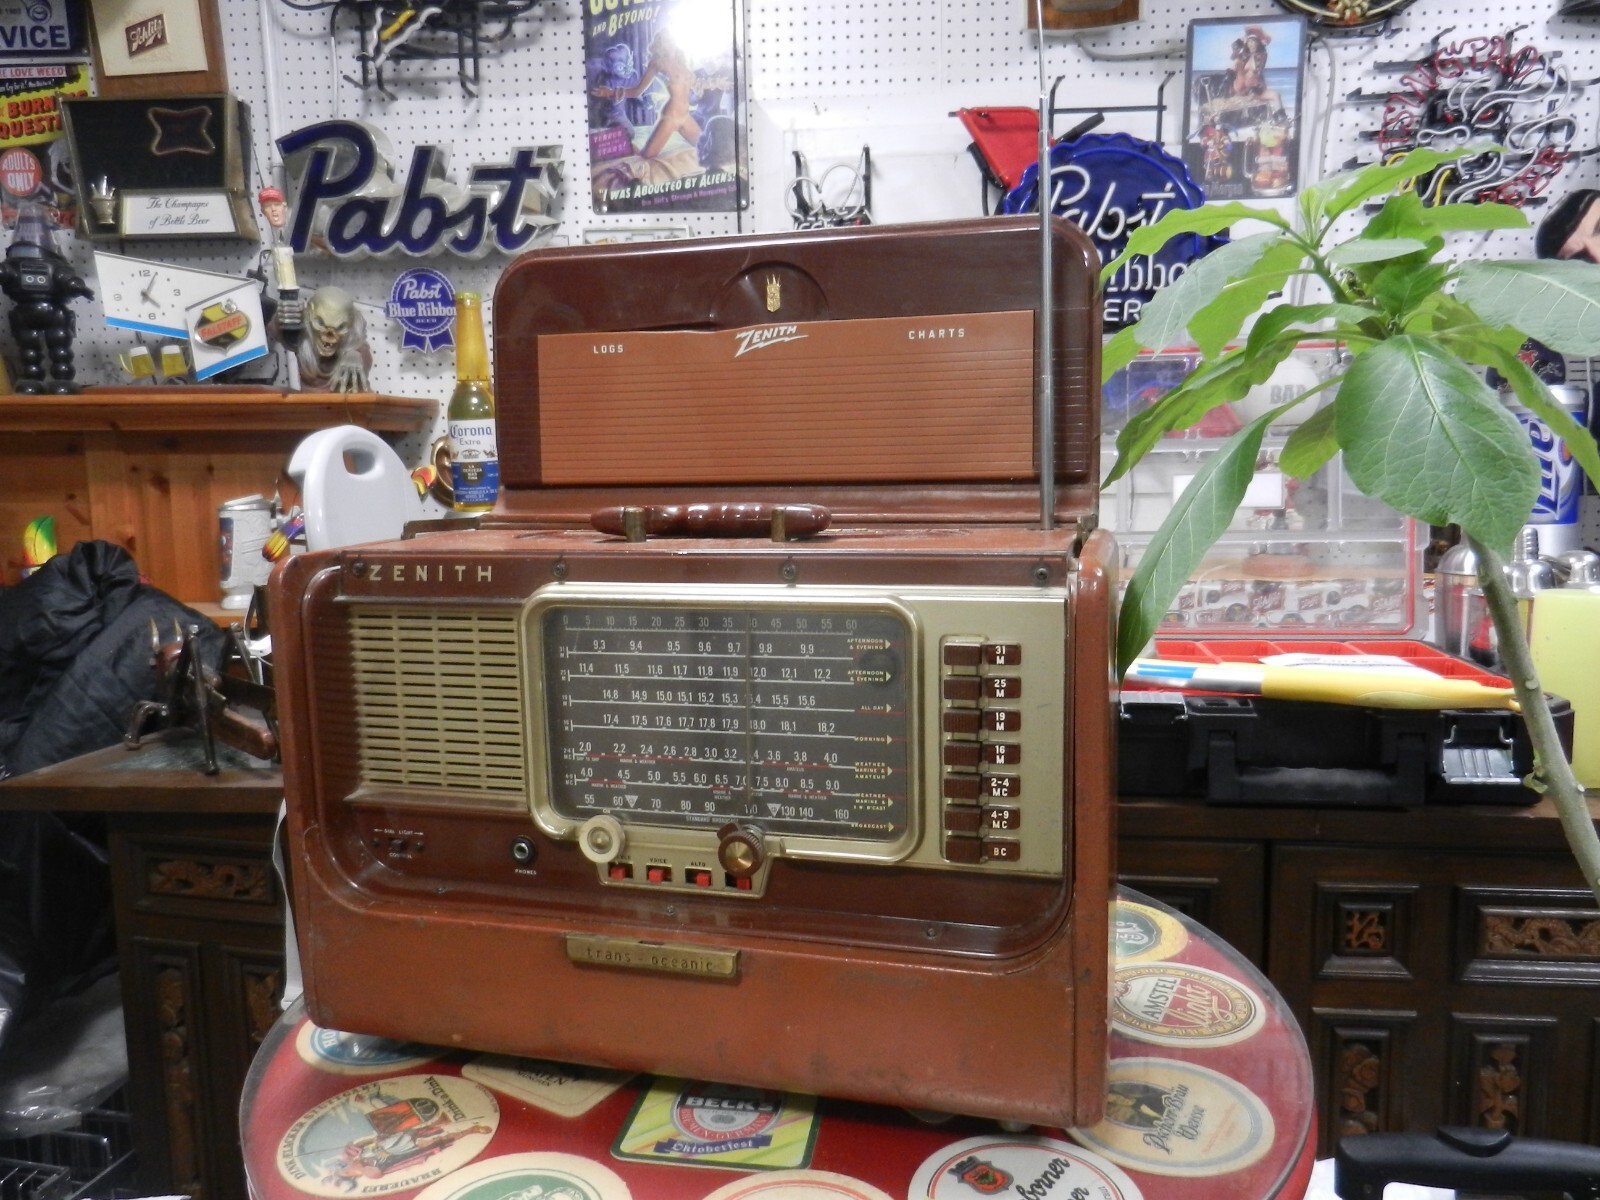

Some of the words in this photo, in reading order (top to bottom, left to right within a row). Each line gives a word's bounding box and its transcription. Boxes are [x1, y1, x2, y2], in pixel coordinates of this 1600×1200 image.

[608, 6, 661, 37] BEYOND!
[36, 67, 64, 76] WEED
[2, 151, 36, 171] ADULTS
[8, 172, 35, 192] ONLY
[275, 120, 545, 254] Pabst
[610, 187, 631, 200] WAS
[634, 179, 682, 199] ABDUCTED
[684, 177, 698, 190] BY
[165, 198, 209, 211] Champagne
[160, 214, 185, 226] Bottle
[187, 213, 211, 225] Beer
[173, 288, 181, 296] 3
[401, 278, 442, 299] Pabst
[149, 312, 156, 320] 6
[388, 302, 416, 317] Blue
[201, 316, 243, 338] FALSTAFF
[908, 328, 966, 340] CHARTS
[735, 325, 809, 357] ZENITH
[593, 344, 624, 354] LOGS
[450, 425, 492, 438] Corona
[460, 438, 481, 446] Extra
[369, 565, 492, 582] ZENITH
[585, 615, 591, 626] 5
[606, 616, 615, 626] 10
[628, 616, 637, 626] 15
[652, 616, 662, 627] 20
[674, 616, 685, 627] 25
[699, 617, 709, 628] 30
[722, 617, 733, 628] 35
[771, 618, 781, 628] 45
[796, 618, 807, 629] 50
[821, 618, 832, 629] 55
[846, 619, 857, 630] 60
[593, 640, 606, 650] 9.3
[630, 640, 643, 650] 9.4
[667, 641, 681, 652] 9.5
[698, 641, 712, 652] 9.6
[727, 642, 741, 653] 9.7
[758, 643, 773, 654] 9.8
[800, 644, 814, 654] 9.9
[995, 646, 1006, 654] 31
[996, 656, 1005, 664] M
[579, 663, 594, 673] 11.4
[615, 663, 630, 674] 11.5
[648, 664, 663, 675] 11.6
[673, 665, 688, 675] 11.7
[698, 666, 713, 676] 11.8
[723, 666, 738, 676] 11.9
[781, 668, 797, 678] 12.1
[814, 668, 831, 679] 12.2
[994, 679, 1006, 688] 25
[603, 689, 619, 699] 14.8
[631, 690, 648, 700] 14.9
[656, 691, 673, 701] 15.0
[677, 691, 693, 702] 15.1
[698, 692, 714, 703] 15.2
[721, 693, 738, 704] 15.3
[771, 694, 789, 705] 15.5
[798, 695, 816, 706] 15.6
[996, 689, 1005, 698] M
[995, 712, 1006, 721] 19
[603, 714, 619, 724] 17.4
[631, 715, 648, 725] 17.5
[655, 716, 671, 726] 17.6
[678, 717, 694, 727] 17.7
[699, 718, 716, 728] 17.8
[722, 719, 739, 729] 17.9
[781, 721, 796, 731] 18.1
[817, 722, 835, 733] 18.2
[996, 722, 1005, 731] M
[579, 742, 592, 752] 2.0
[613, 743, 626, 753] 2.2
[640, 744, 653, 755] 2.4
[663, 745, 677, 756] 2.6
[684, 746, 697, 757] 2.8
[704, 747, 718, 758] 3.0
[724, 748, 737, 759] 3.2
[767, 750, 781, 761] 3.6
[794, 751, 807, 762] 3.8
[824, 752, 838, 764] 4.0
[995, 745, 1005, 754] 16
[996, 755, 1005, 764] M
[580, 768, 593, 777] 4.0
[618, 770, 630, 779] 4.5
[648, 771, 661, 781] 5.0
[673, 772, 686, 782] 5.5
[693, 773, 707, 783] 6.0
[715, 774, 728, 784] 6.5
[756, 777, 769, 787] 7.5
[775, 777, 789, 788] 8.0
[800, 778, 814, 789] 8.5
[825, 780, 840, 790] 9.0
[991, 778, 1009, 787] 2-4
[992, 788, 1008, 797] MC
[585, 794, 595, 804] 55
[613, 796, 623, 806] 60
[651, 799, 661, 809] 70
[681, 800, 691, 810] 80
[705, 802, 715, 812] 90
[781, 806, 795, 816] 130
[799, 807, 814, 817] 140
[834, 809, 849, 819] 160
[991, 810, 1009, 819] 4-9
[992, 820, 1008, 829] MC
[1141, 978, 1178, 1021] AMSTEL
